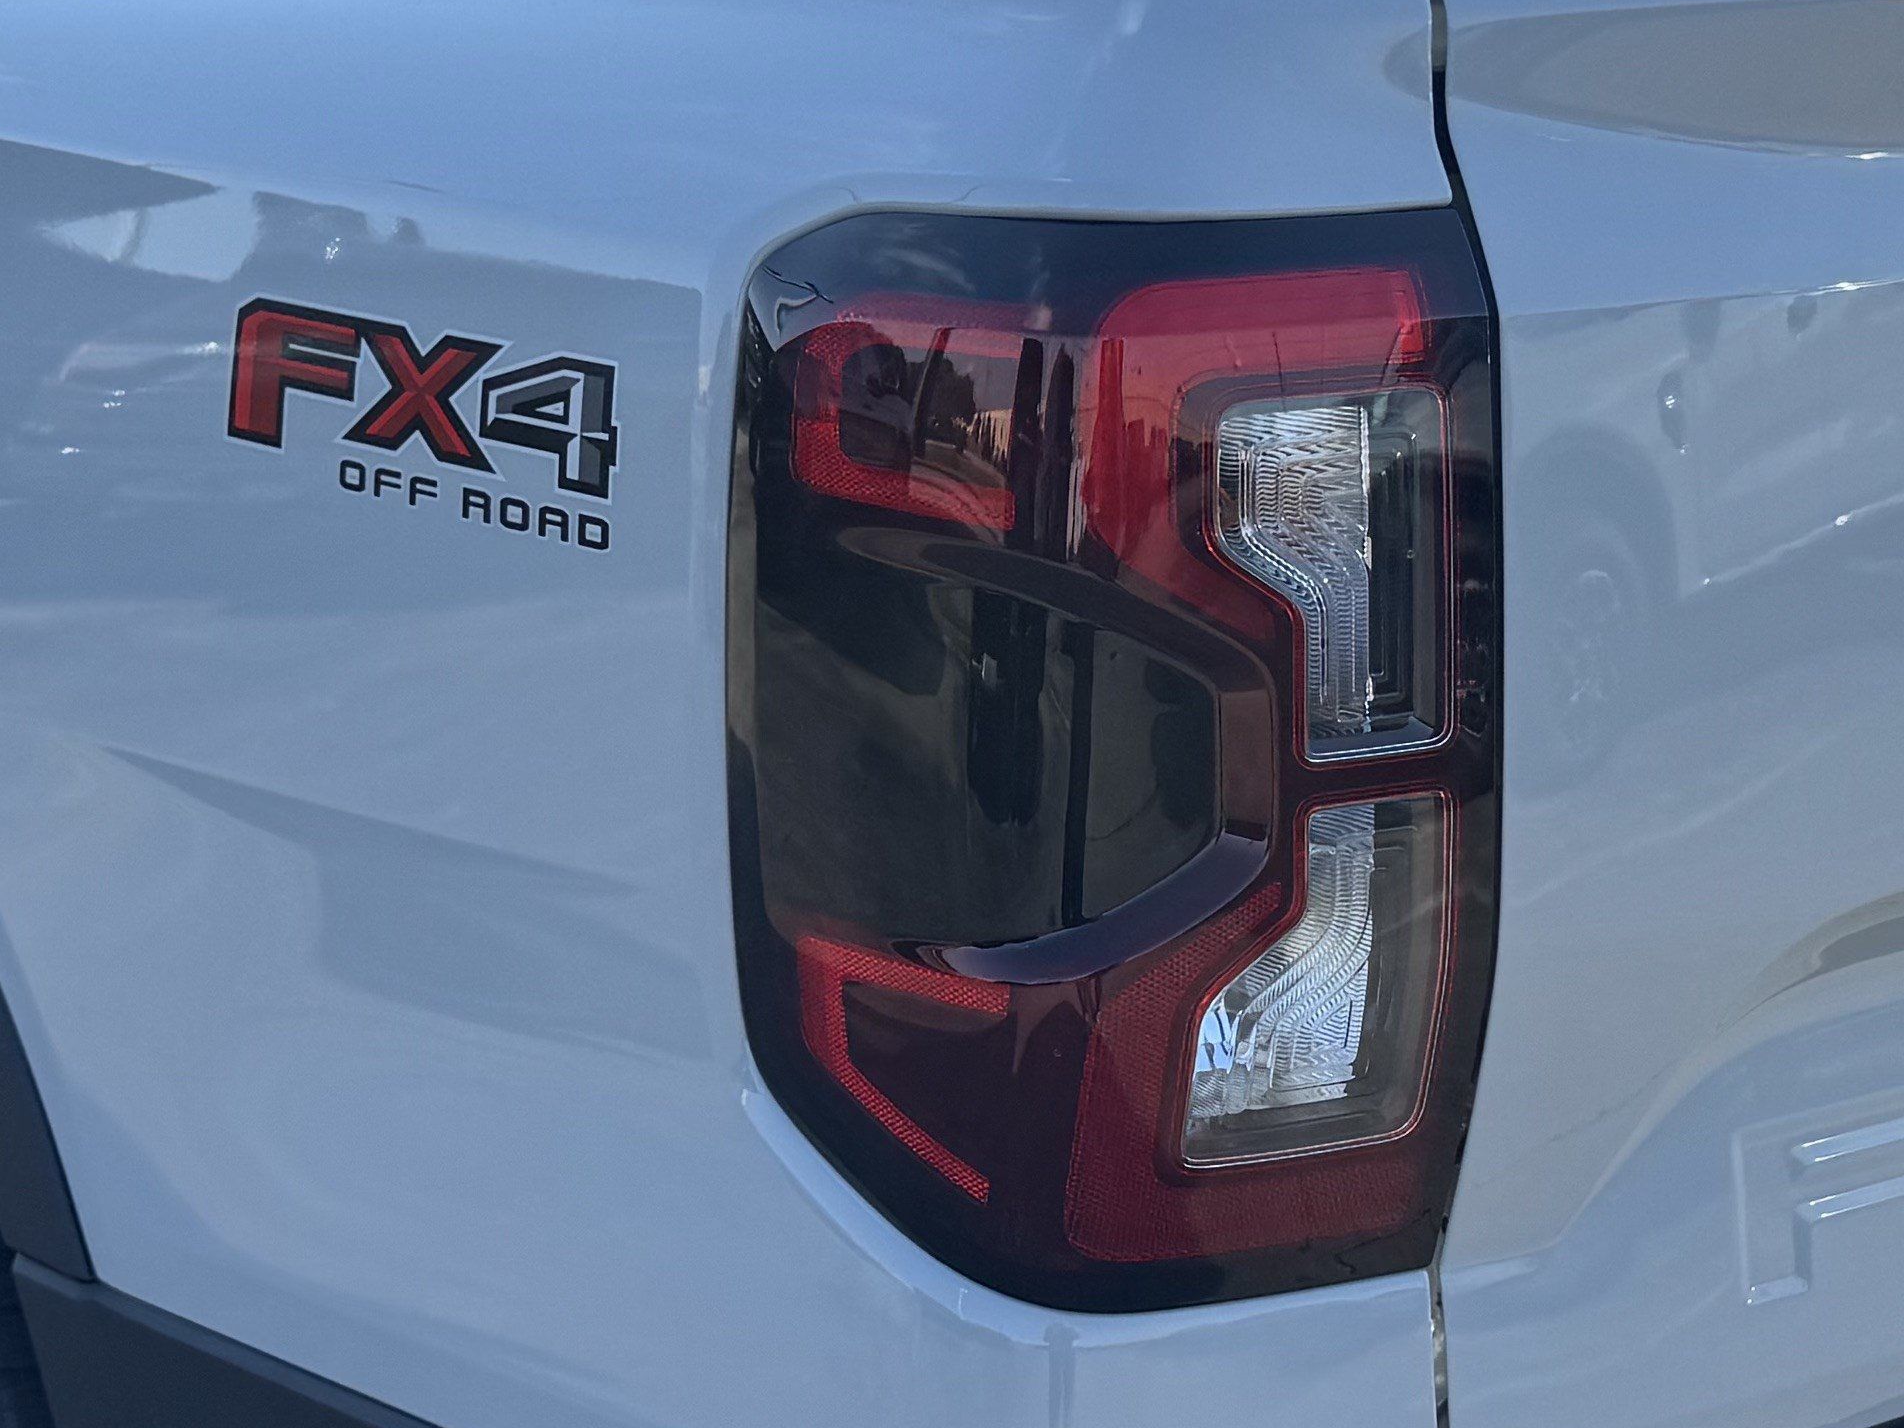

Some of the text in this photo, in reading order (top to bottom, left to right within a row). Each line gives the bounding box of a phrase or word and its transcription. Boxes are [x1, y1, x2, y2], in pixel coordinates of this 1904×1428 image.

[226, 294, 620, 502] FX4
[338, 458, 612, 552] OFF ROAD
